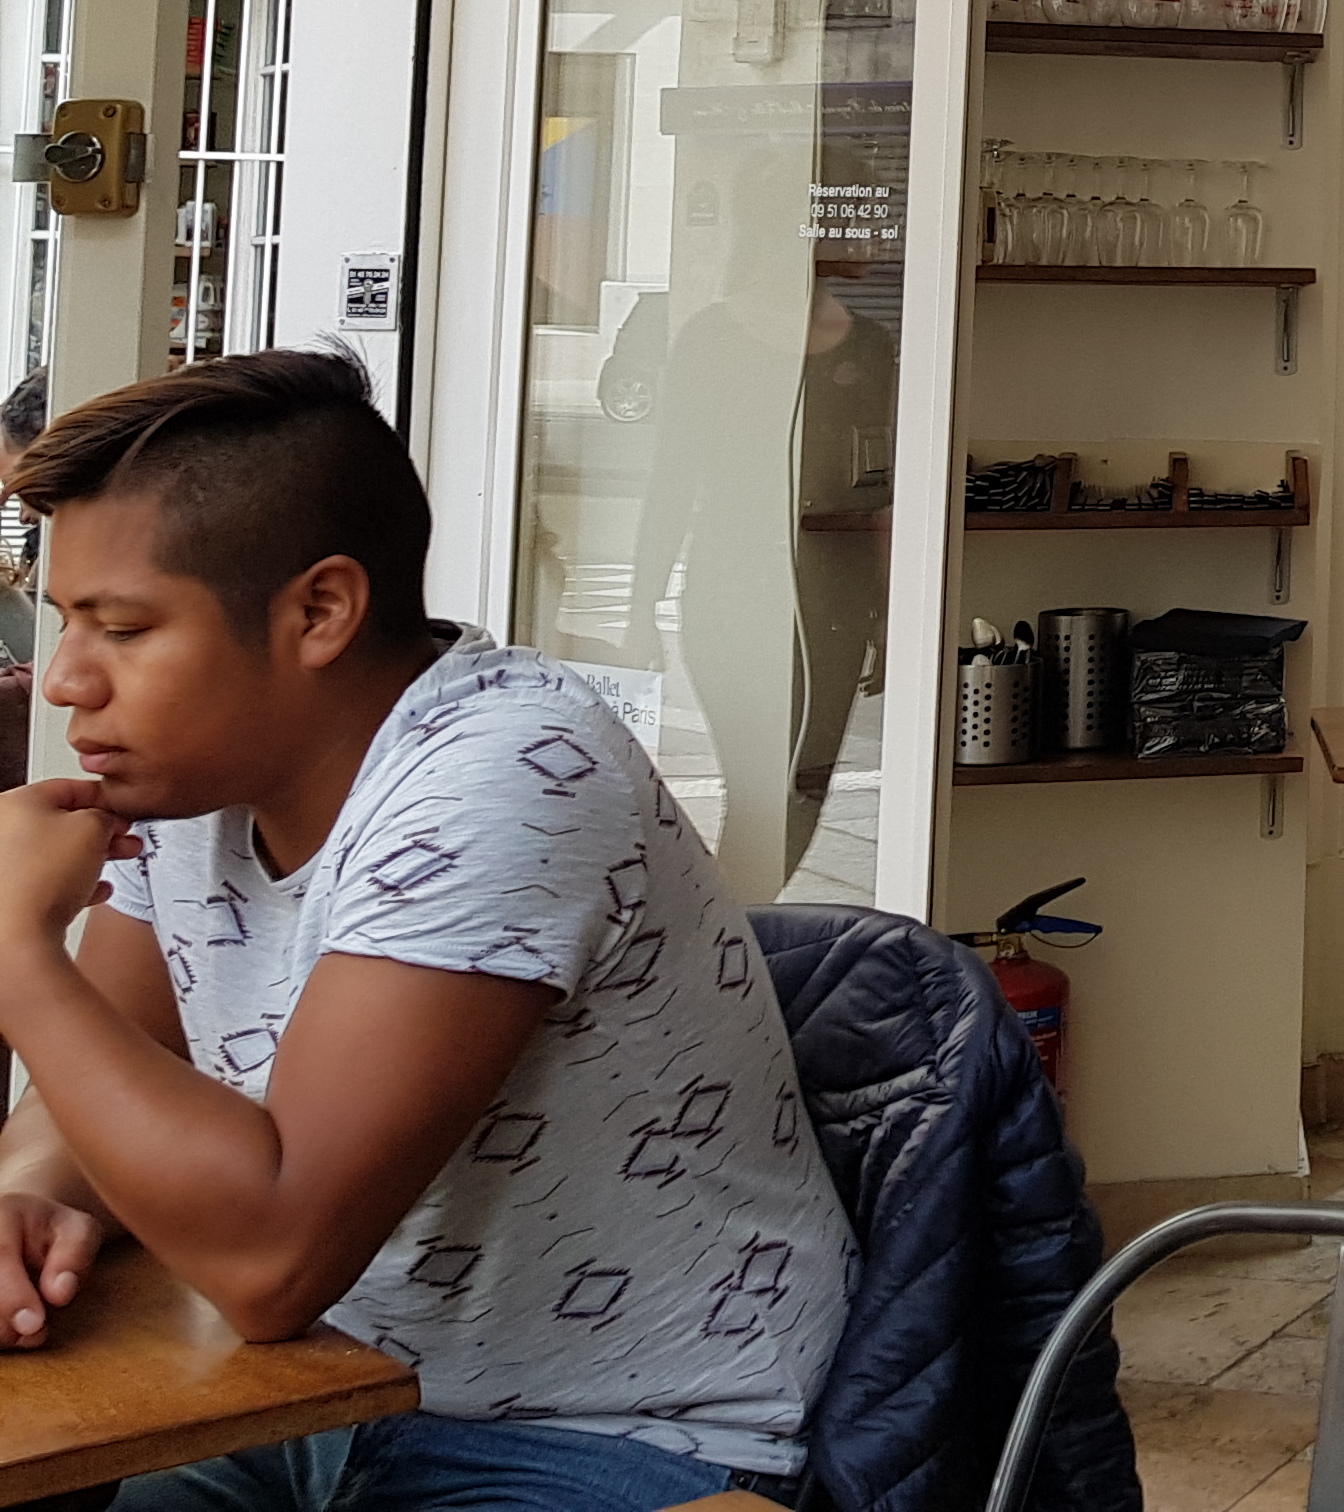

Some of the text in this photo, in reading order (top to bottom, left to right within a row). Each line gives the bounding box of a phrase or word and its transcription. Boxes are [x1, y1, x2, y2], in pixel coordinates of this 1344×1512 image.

[808, 183, 889, 198] Réservation au
[811, 204, 889, 218] 09 51 06 42 90
[798, 224, 826, 238] Salle
[828, 226, 842, 238] au
[845, 226, 871, 239] sous
[881, 225, 898, 239] sol
